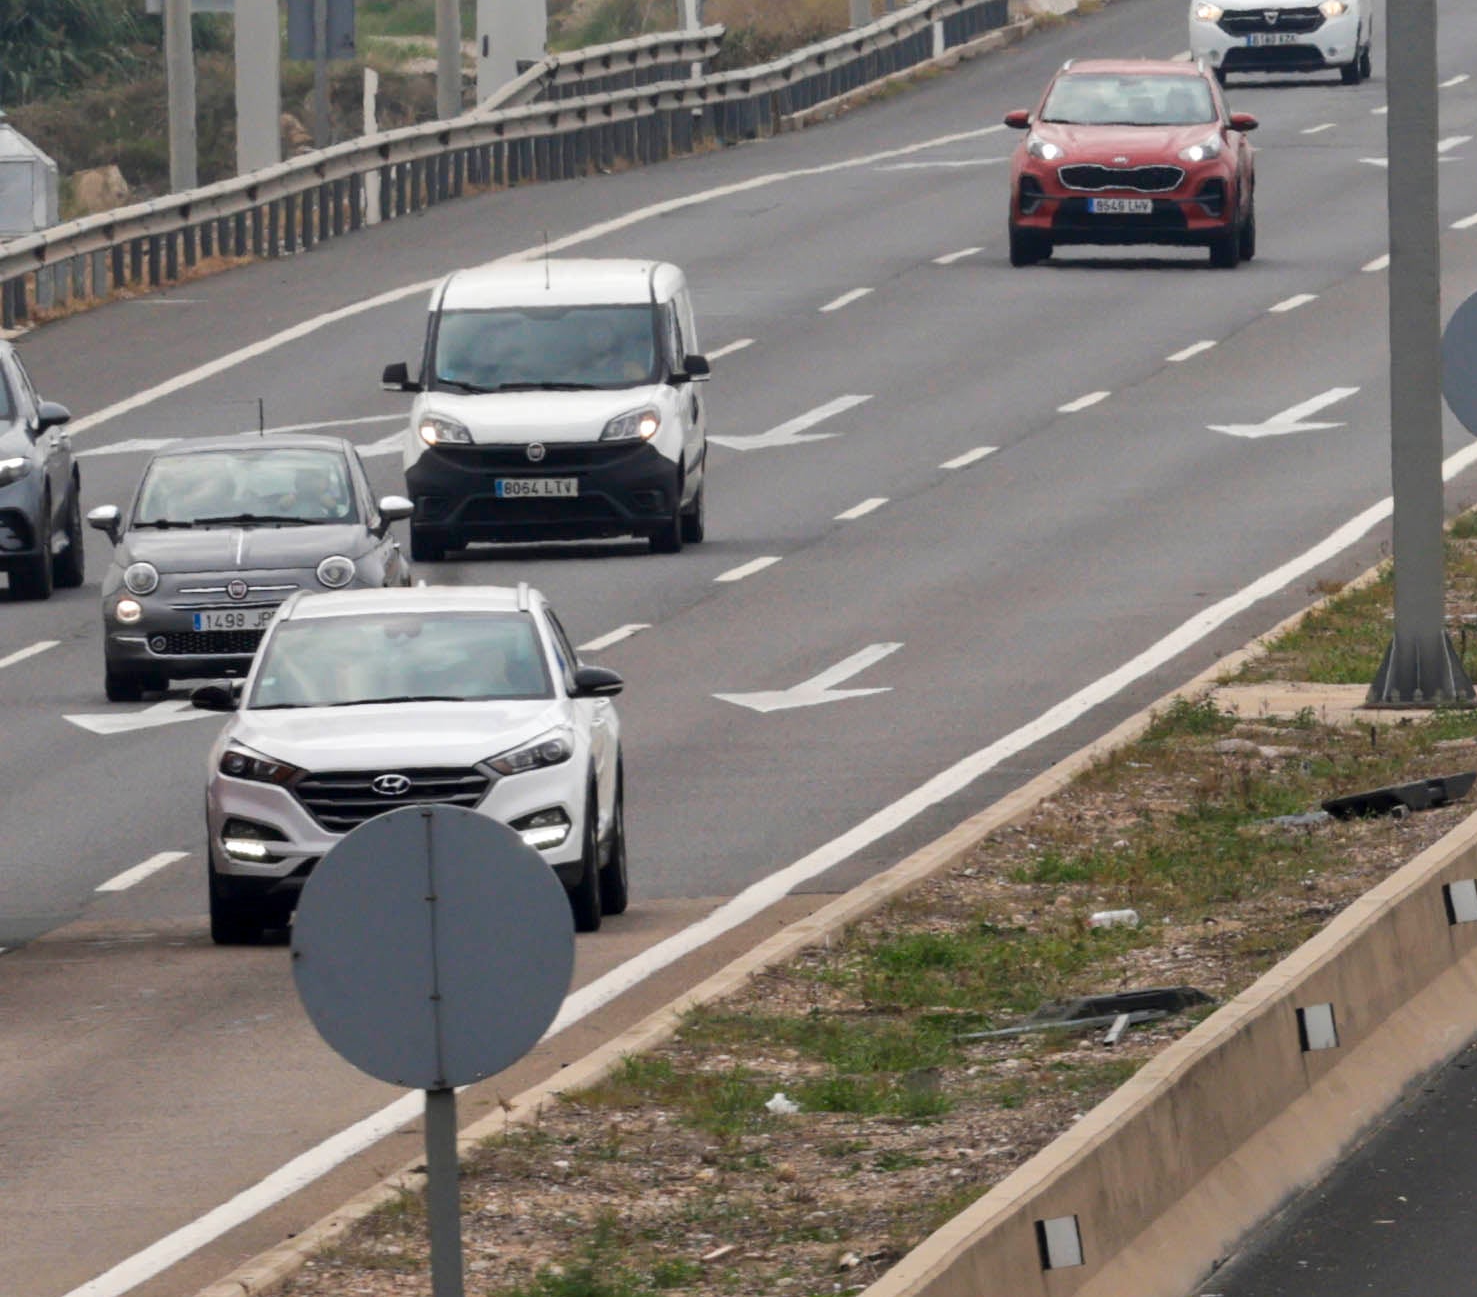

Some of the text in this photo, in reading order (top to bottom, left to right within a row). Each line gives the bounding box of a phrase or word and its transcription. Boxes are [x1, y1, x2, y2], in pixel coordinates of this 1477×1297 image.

[504, 481, 572, 495] 8064 LTV
[206, 612, 246, 630] 1498
